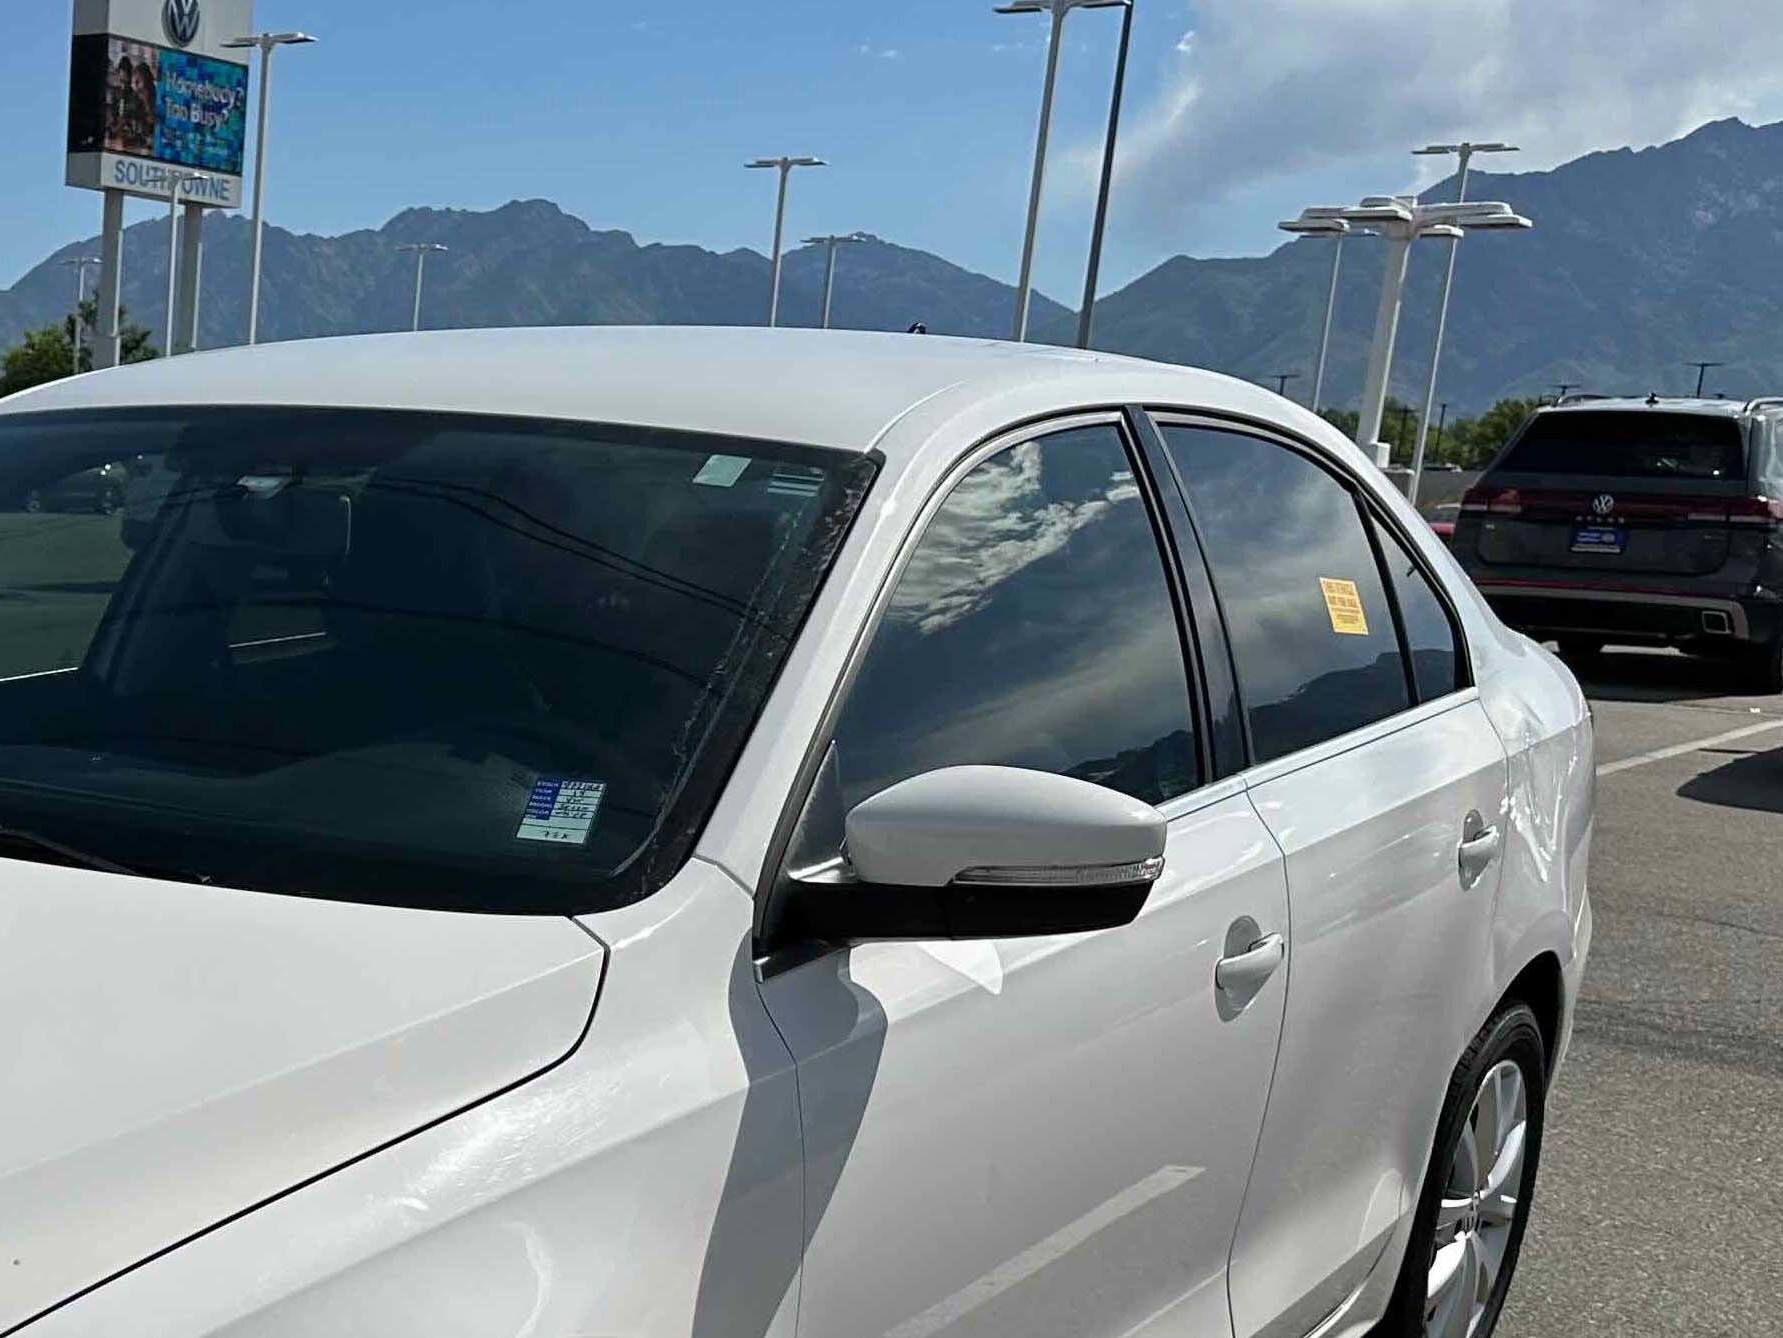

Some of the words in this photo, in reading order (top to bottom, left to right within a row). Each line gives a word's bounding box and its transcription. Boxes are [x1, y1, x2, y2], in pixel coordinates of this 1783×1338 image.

[165, 71, 244, 110] Homebody?
[165, 97, 189, 121] Too
[190, 103, 229, 132] Busy?
[114, 160, 231, 200] SOUTHOWNE
